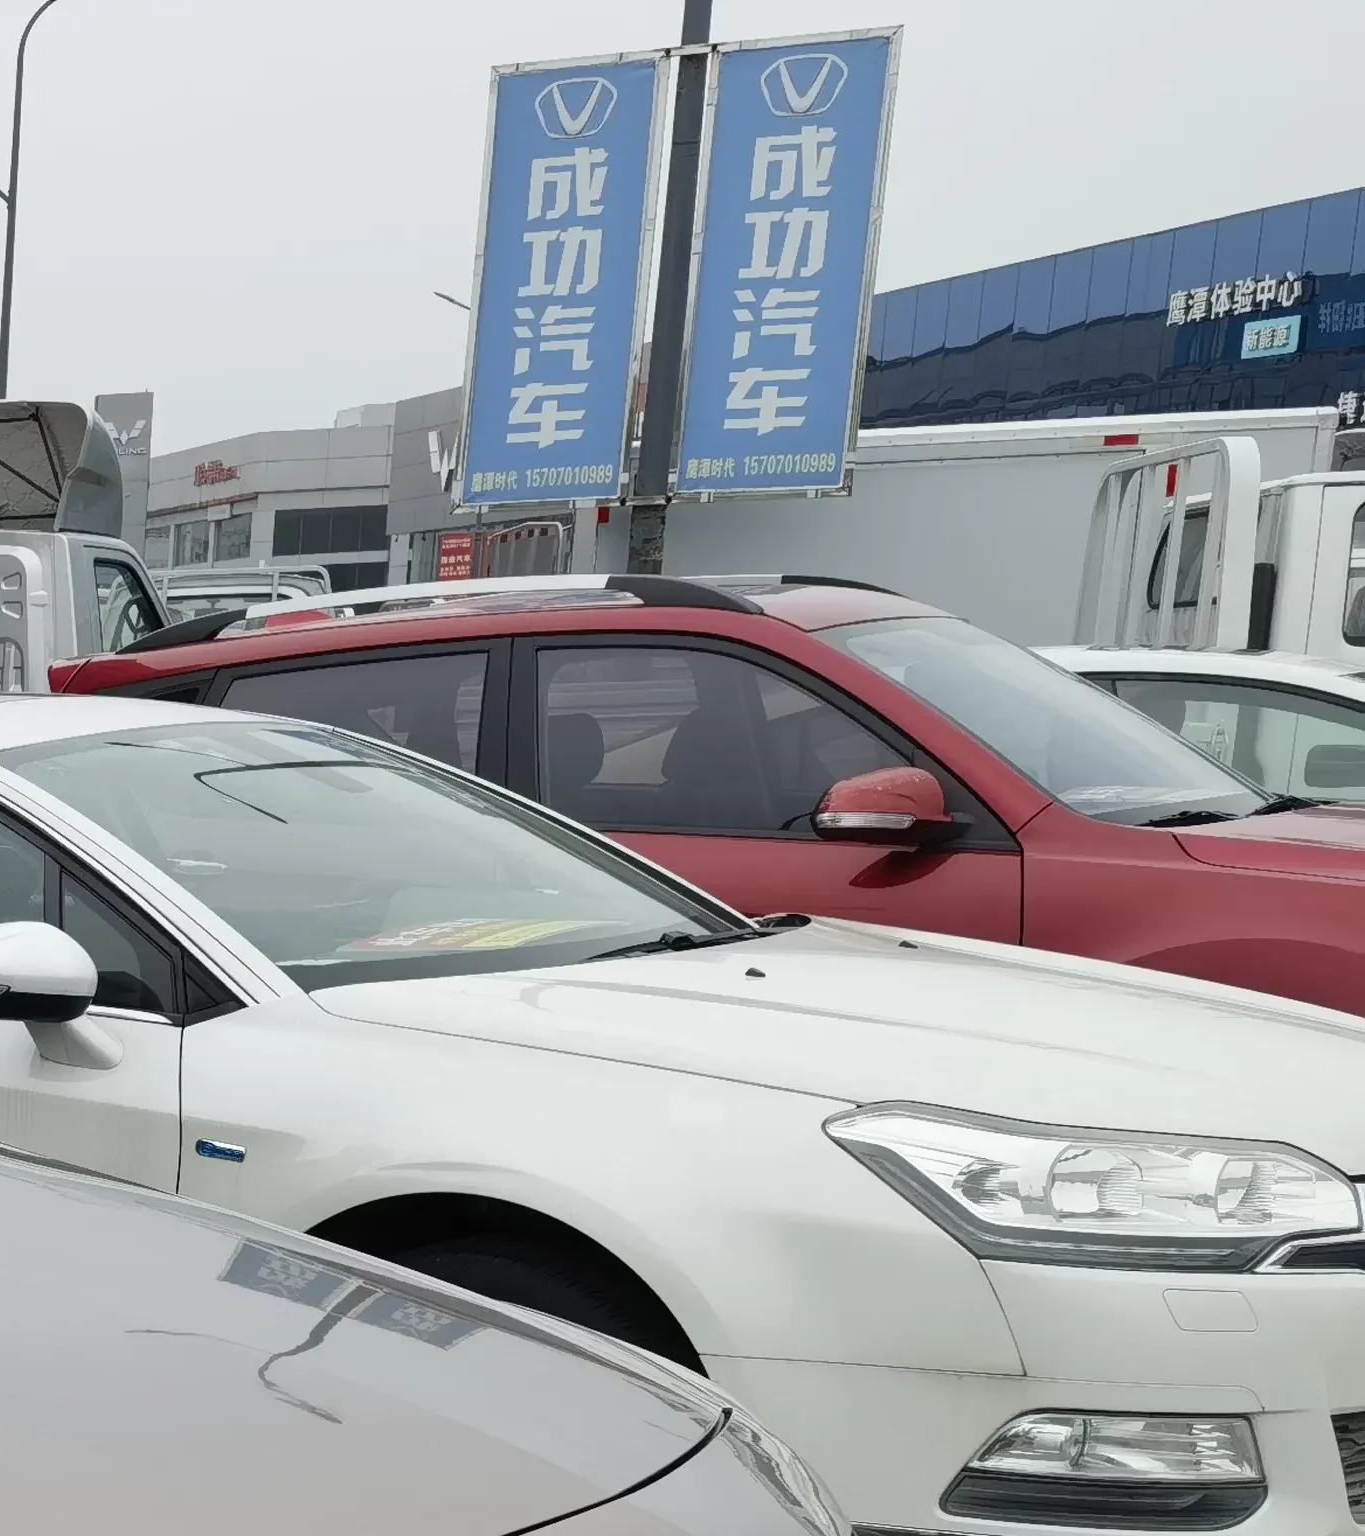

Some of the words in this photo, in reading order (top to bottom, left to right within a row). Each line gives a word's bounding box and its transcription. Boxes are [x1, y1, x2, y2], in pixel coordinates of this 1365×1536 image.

[722, 125, 837, 437] 成功汽车
[505, 147, 609, 449] 成功汽车
[1166, 271, 1303, 327] 鹰潭体验中心
[1245, 324, 1292, 351] 新能源
[119, 446, 147, 456] LING
[744, 453, 837, 476] 15707010989
[525, 464, 613, 488] 15707010989
